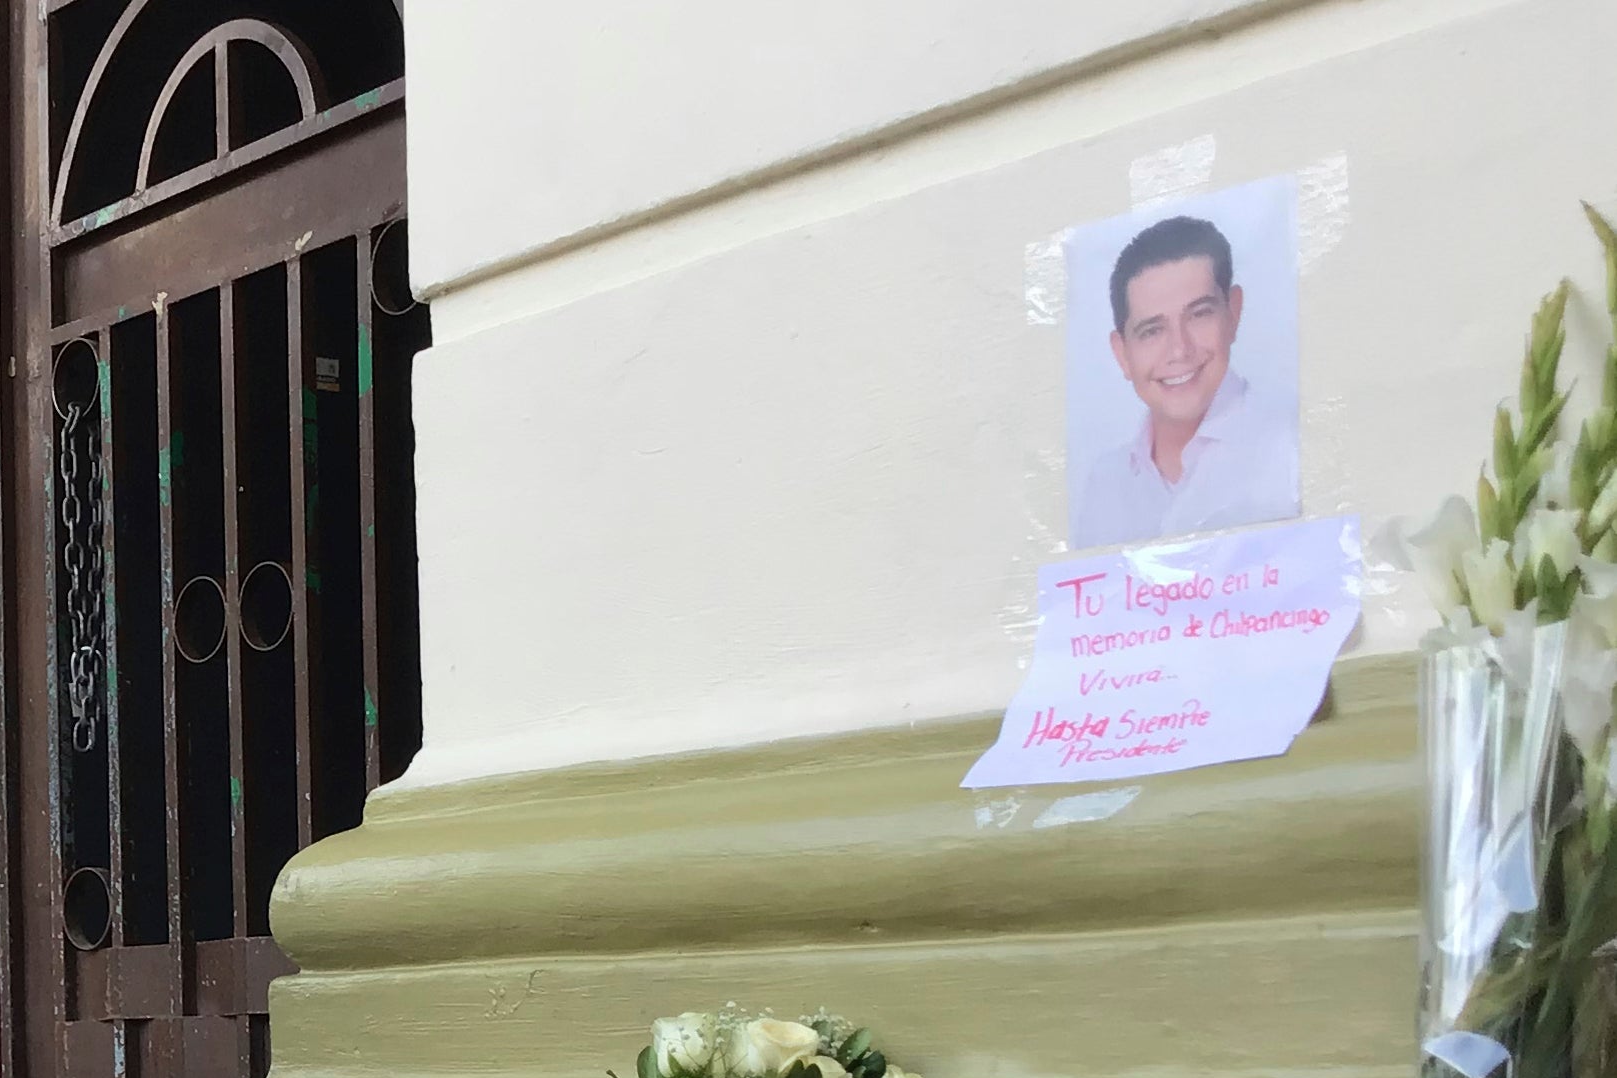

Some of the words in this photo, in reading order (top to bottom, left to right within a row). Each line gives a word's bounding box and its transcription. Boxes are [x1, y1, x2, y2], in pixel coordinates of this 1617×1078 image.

[1055, 572, 1108, 619] Tu
[1125, 572, 1215, 617] legado
[1221, 573, 1249, 595] en
[1262, 564, 1279, 588] la
[1070, 626, 1171, 658] memoria
[1182, 613, 1204, 638] de
[1022, 706, 1111, 749] Hasta
